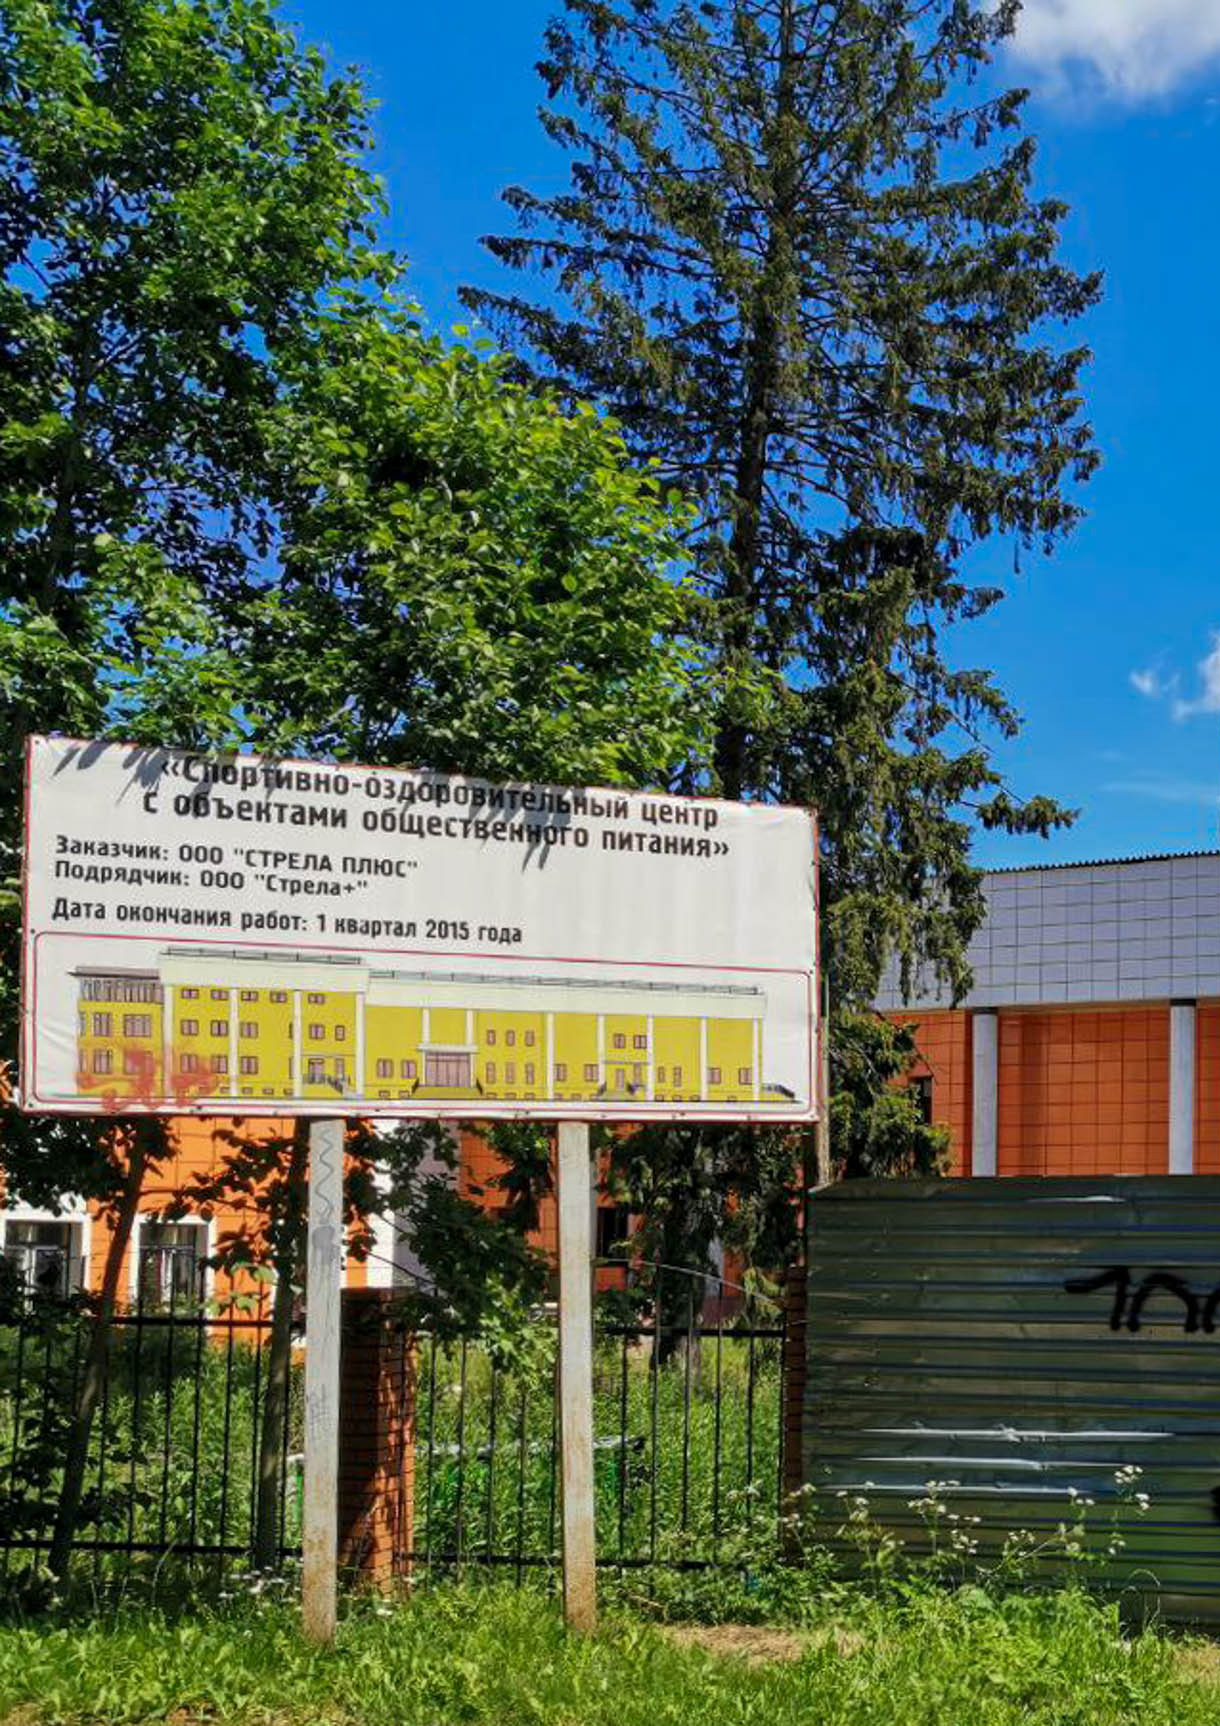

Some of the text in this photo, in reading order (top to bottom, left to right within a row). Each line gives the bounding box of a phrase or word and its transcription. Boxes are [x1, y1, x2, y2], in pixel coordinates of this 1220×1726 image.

[174, 793, 347, 829] объектами
[363, 808, 589, 848] общественного
[602, 834, 730, 858] питания»
[642, 804, 718, 831] центр
[55, 860, 190, 888] Подрядчик:
[201, 870, 244, 889] ООО
[56, 835, 418, 878] Заказчик: ООО "СТРЕЛА ПЛЮС"
[53, 898, 522, 944] Дата окончания работ: 1 квартал 2015 года
